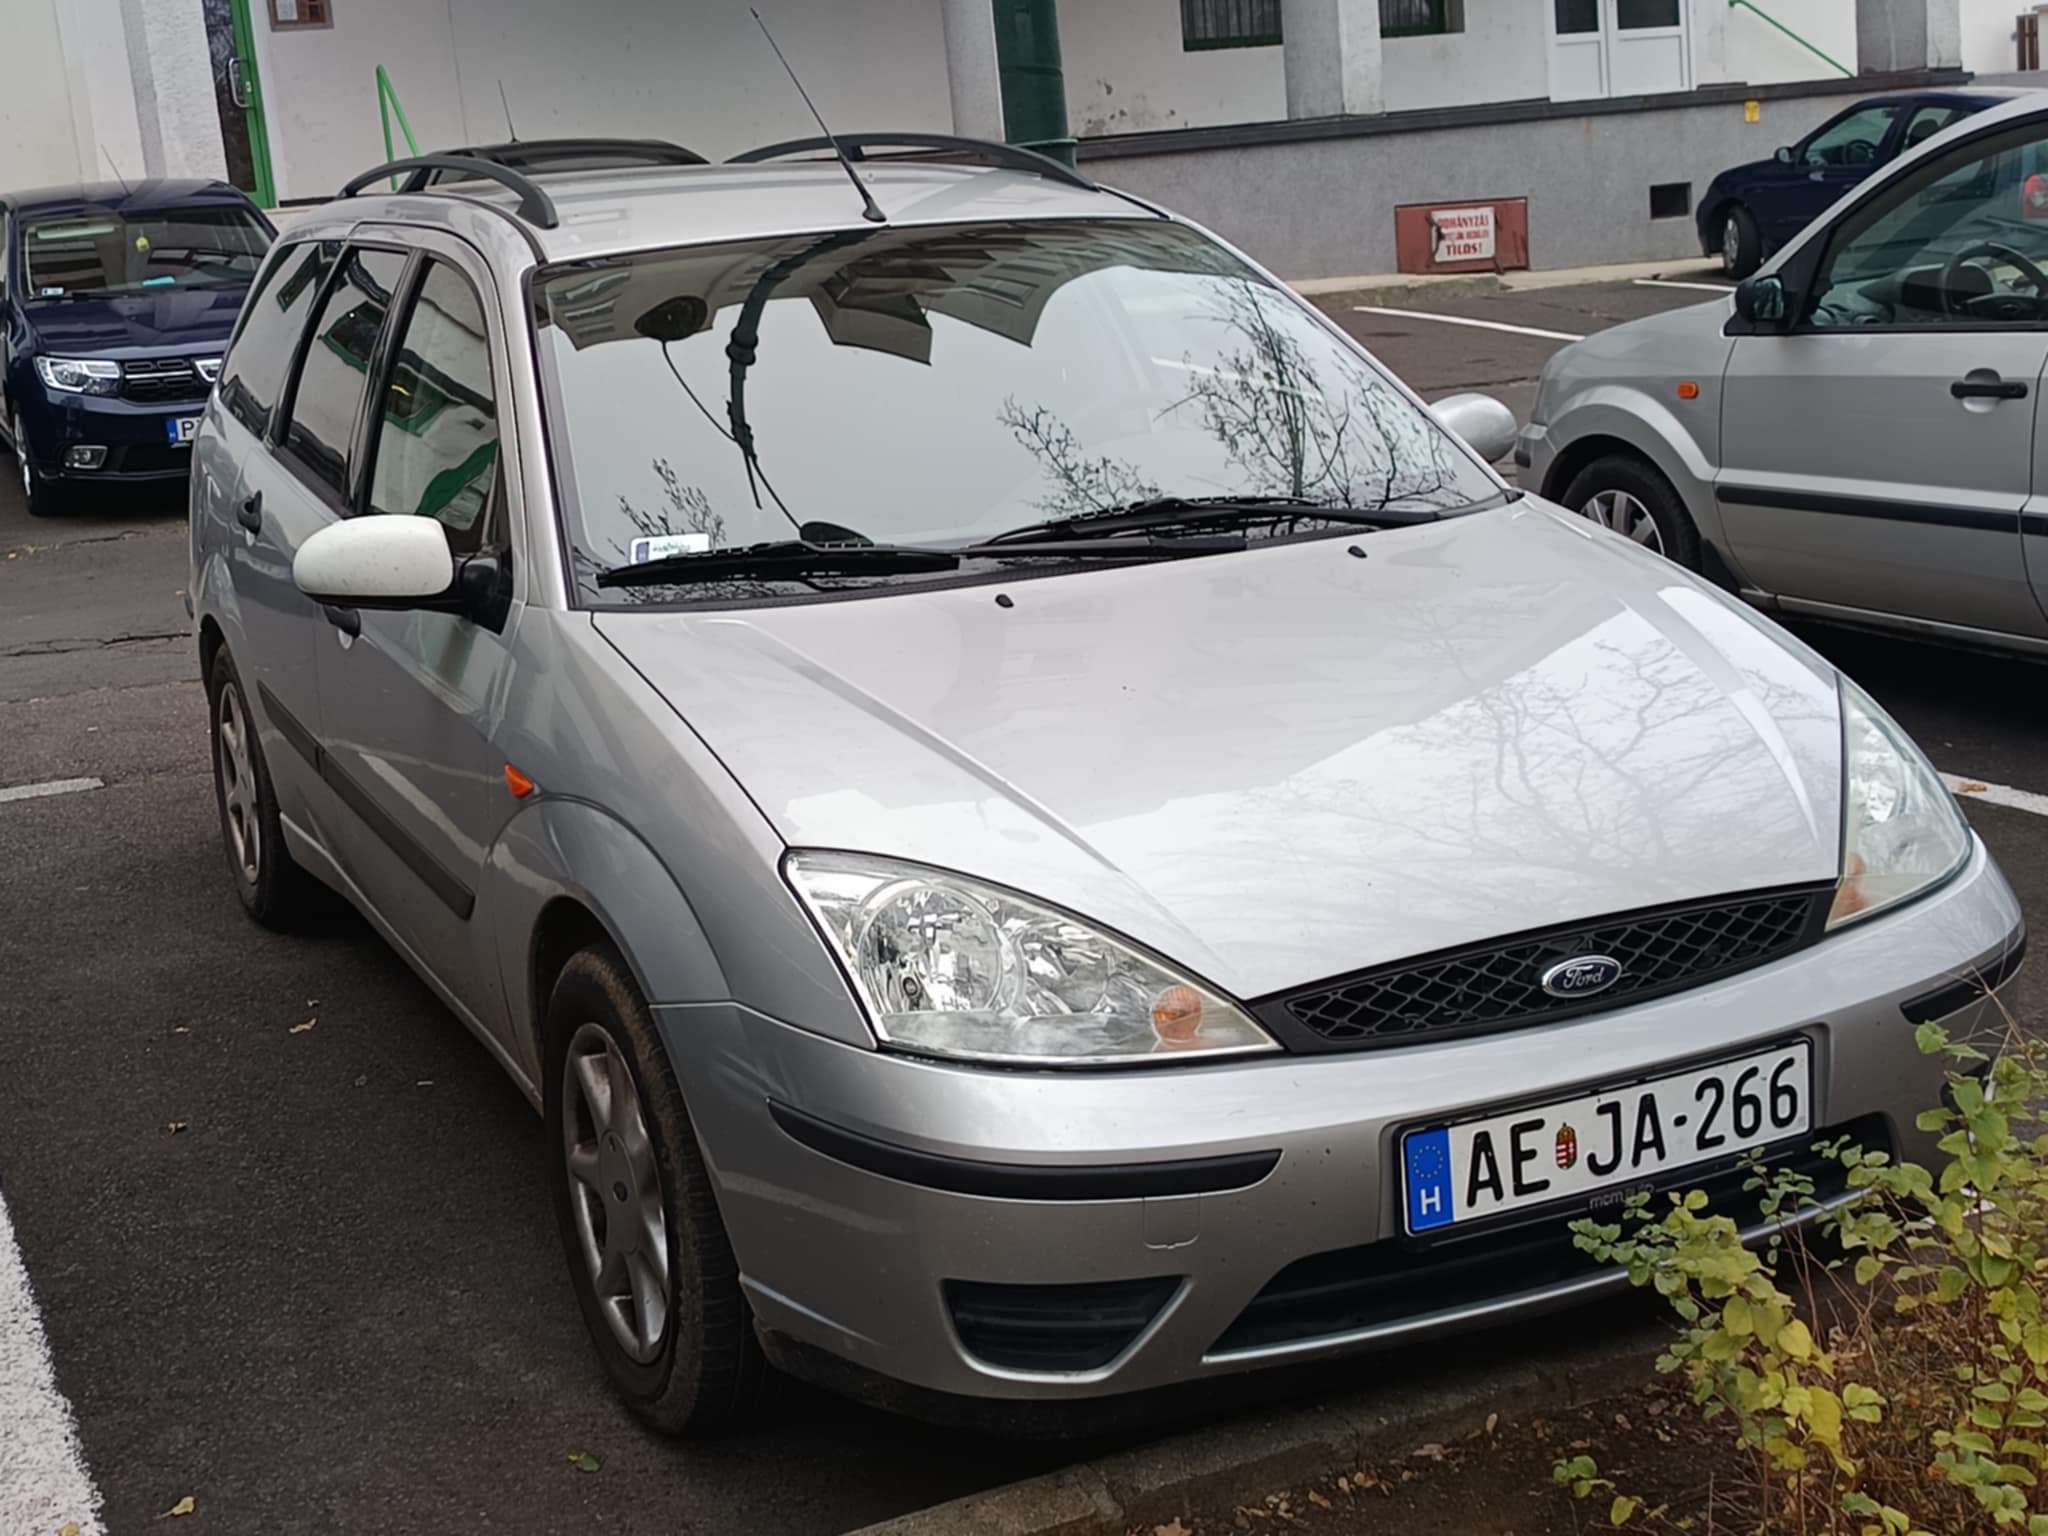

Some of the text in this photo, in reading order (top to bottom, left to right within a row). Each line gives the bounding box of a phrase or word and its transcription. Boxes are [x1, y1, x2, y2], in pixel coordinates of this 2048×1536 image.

[1563, 964, 1605, 989] Ford
[1466, 1056, 1799, 1209] AE JA-266
[1419, 1185, 1441, 1216] H
